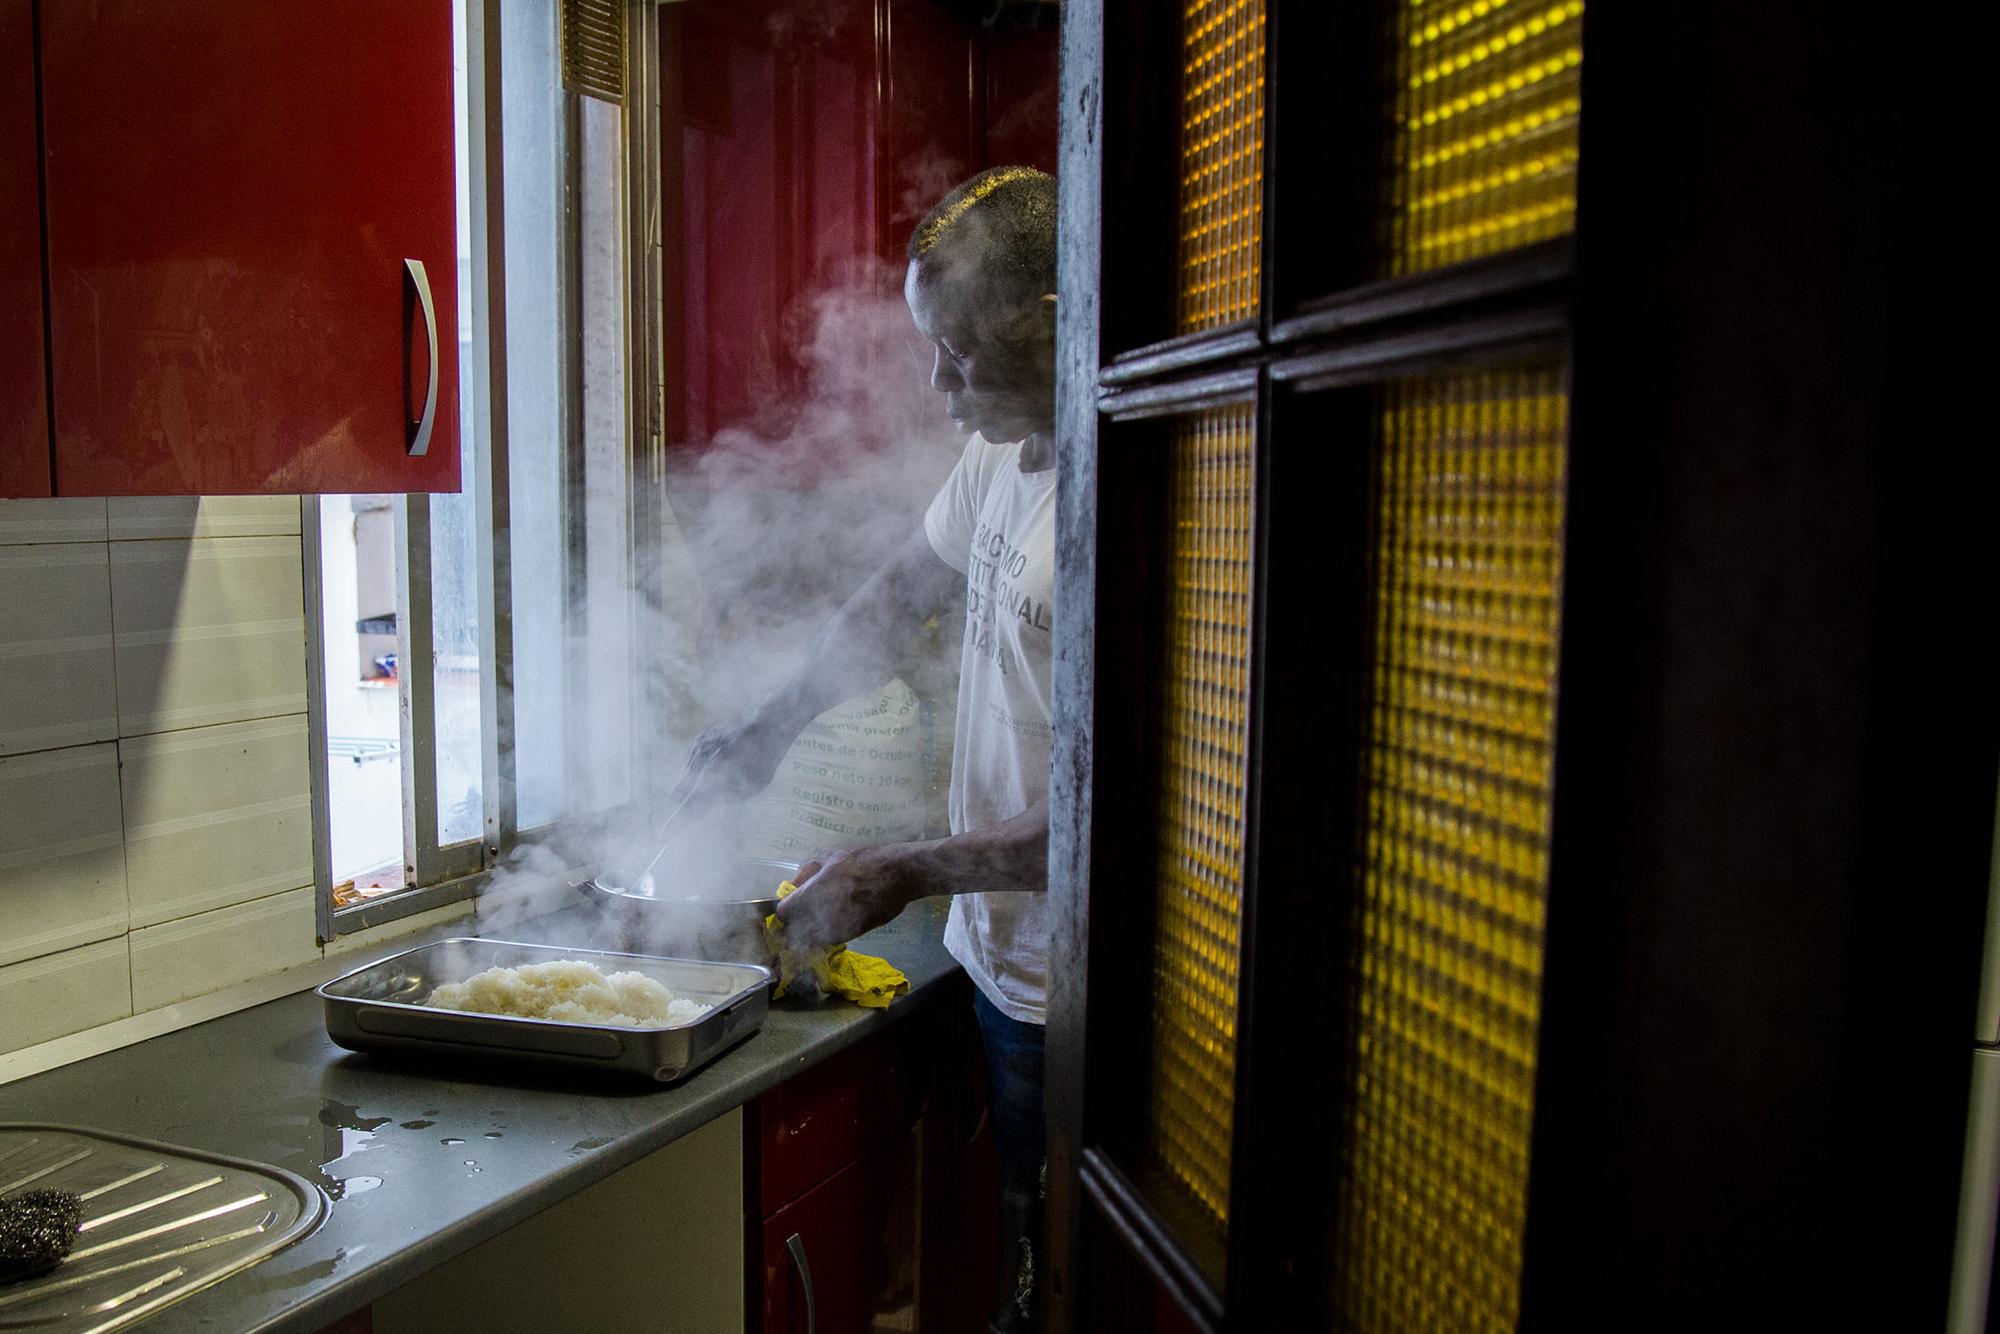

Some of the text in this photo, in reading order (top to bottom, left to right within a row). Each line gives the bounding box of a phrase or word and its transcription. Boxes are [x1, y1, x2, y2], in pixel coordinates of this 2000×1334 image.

[793, 760, 829, 777] Peso
[832, 769, 866, 785] neto
[793, 786, 854, 809] Registro
[789, 808, 854, 835] Producto
